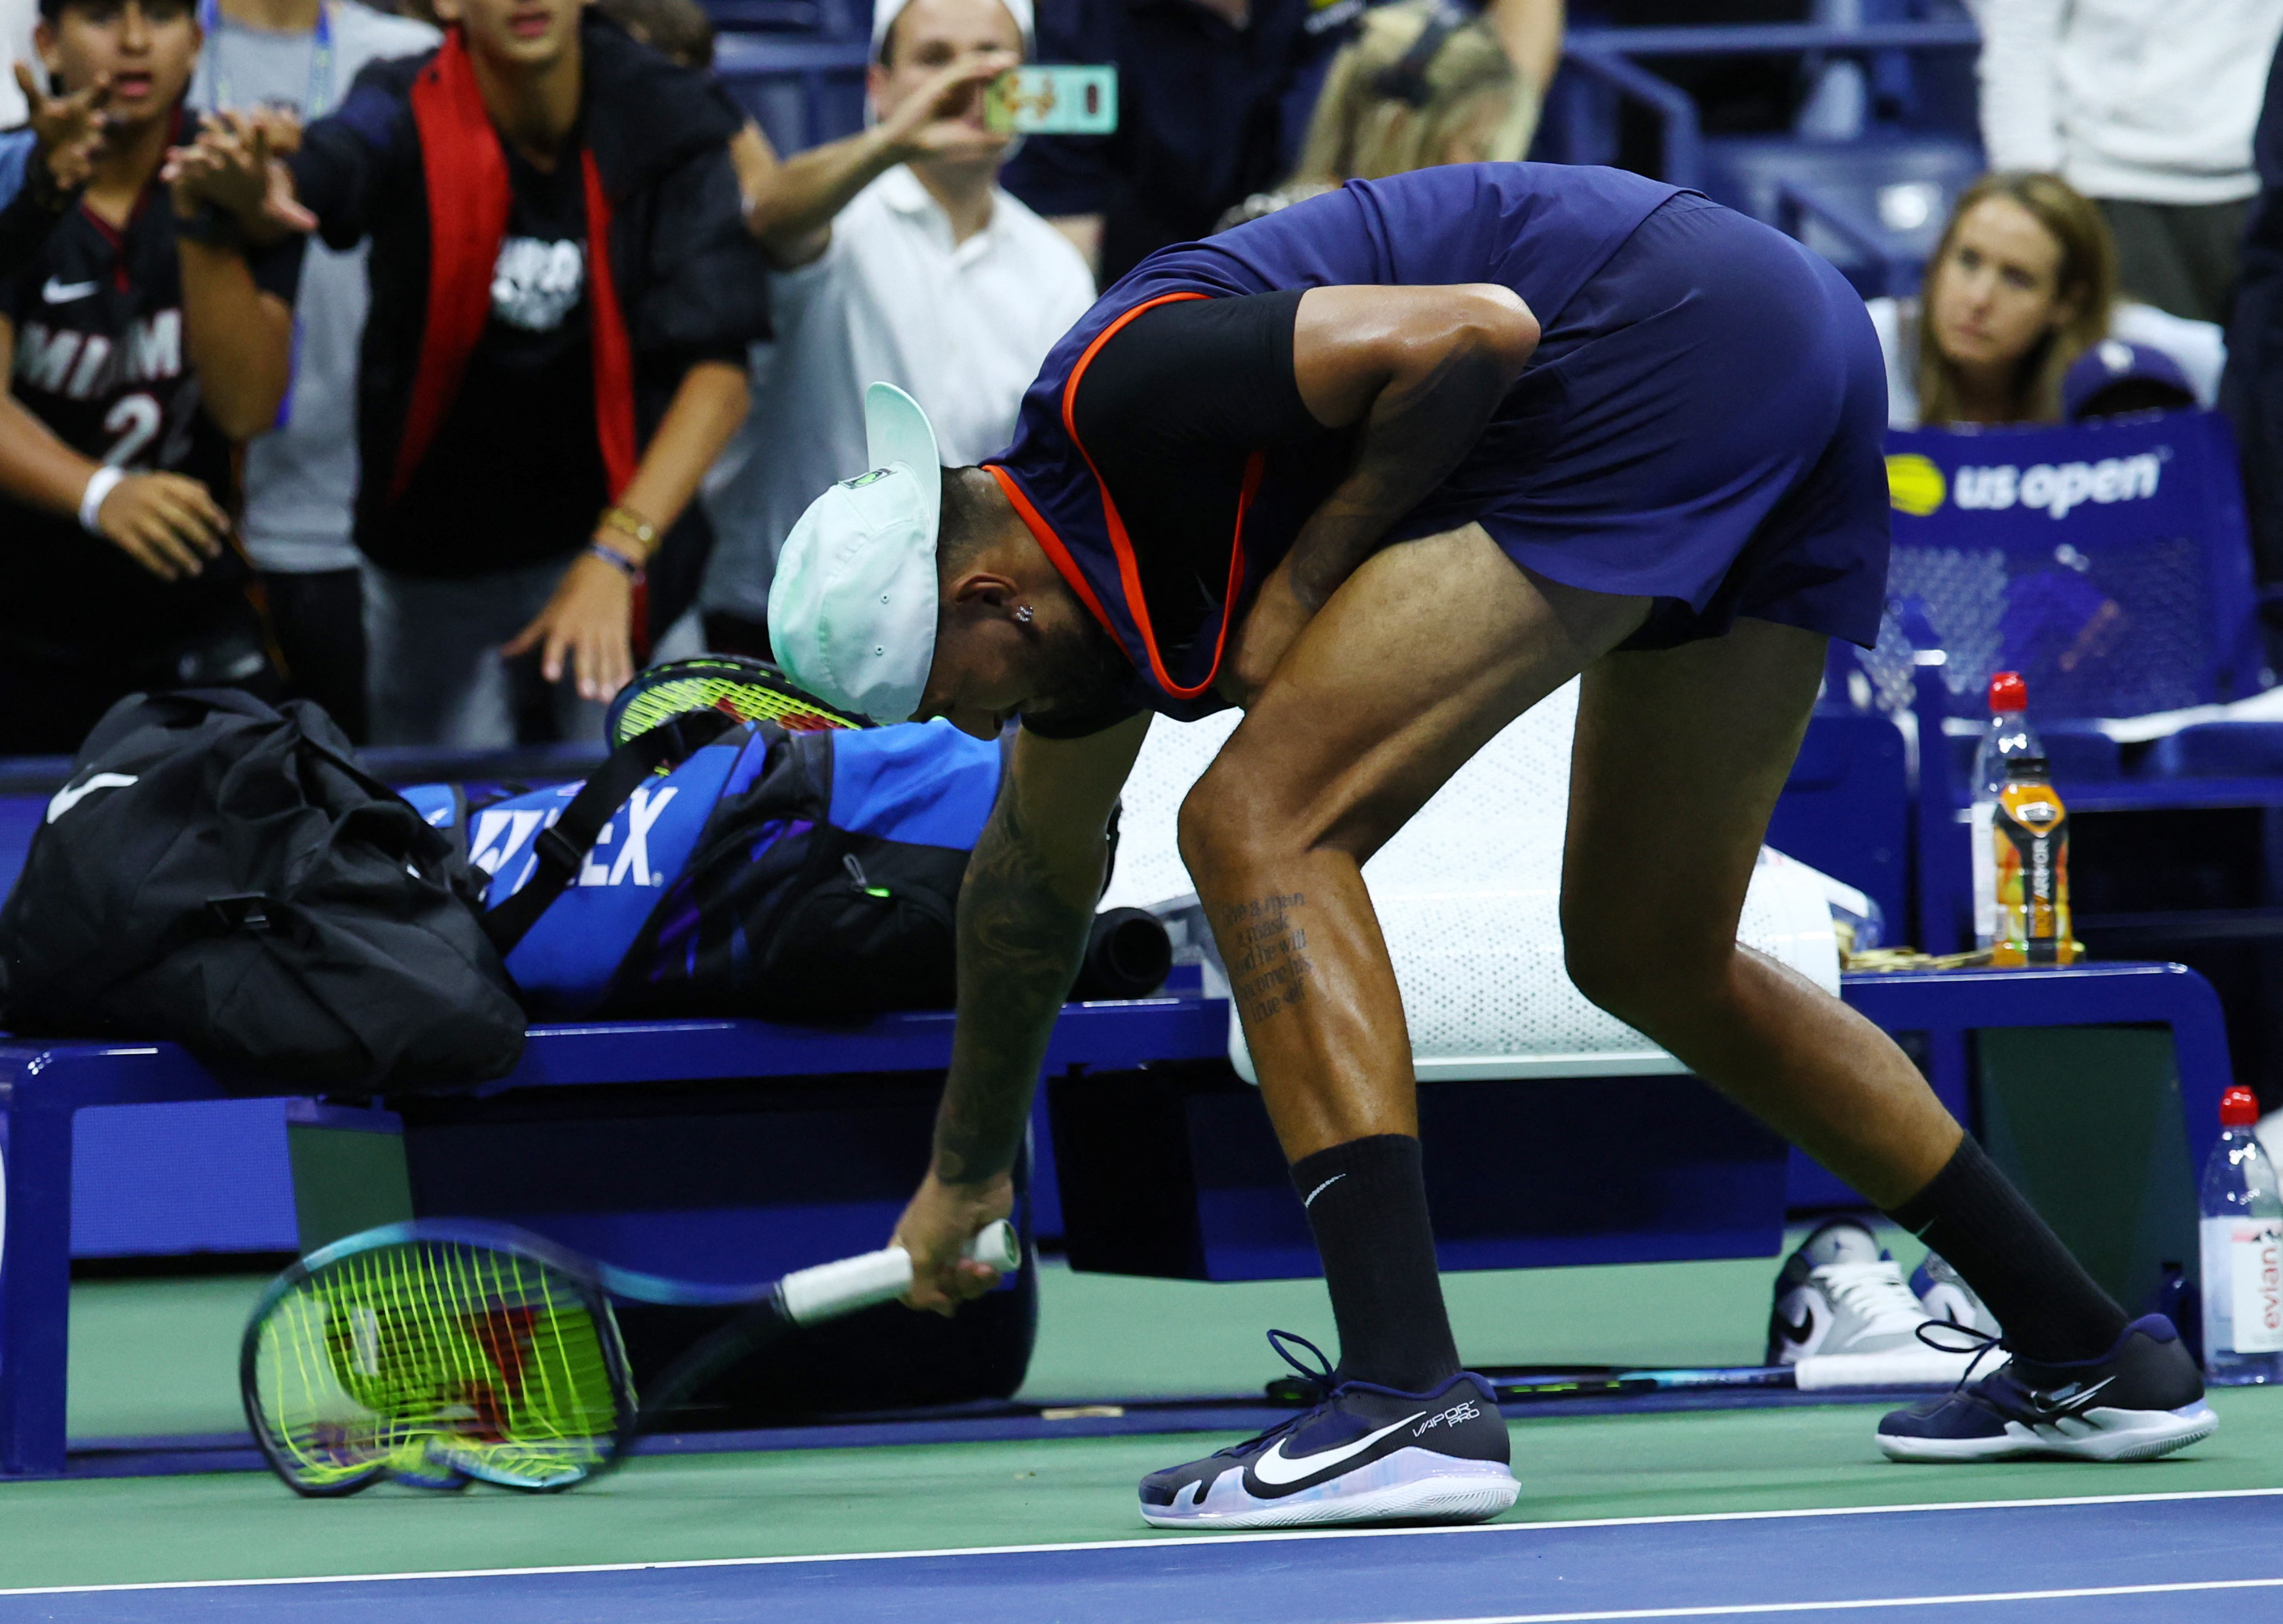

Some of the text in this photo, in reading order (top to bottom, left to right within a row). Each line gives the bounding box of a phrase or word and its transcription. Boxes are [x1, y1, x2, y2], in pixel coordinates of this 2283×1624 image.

[2018, 453, 2161, 520] open
[1264, 893, 1305, 913] man
[1247, 911, 1290, 943] mask
[2259, 1247, 2280, 1330] evian
[1412, 1402, 1471, 1437] VAPOR
[1447, 1408, 1480, 1428] PRO
